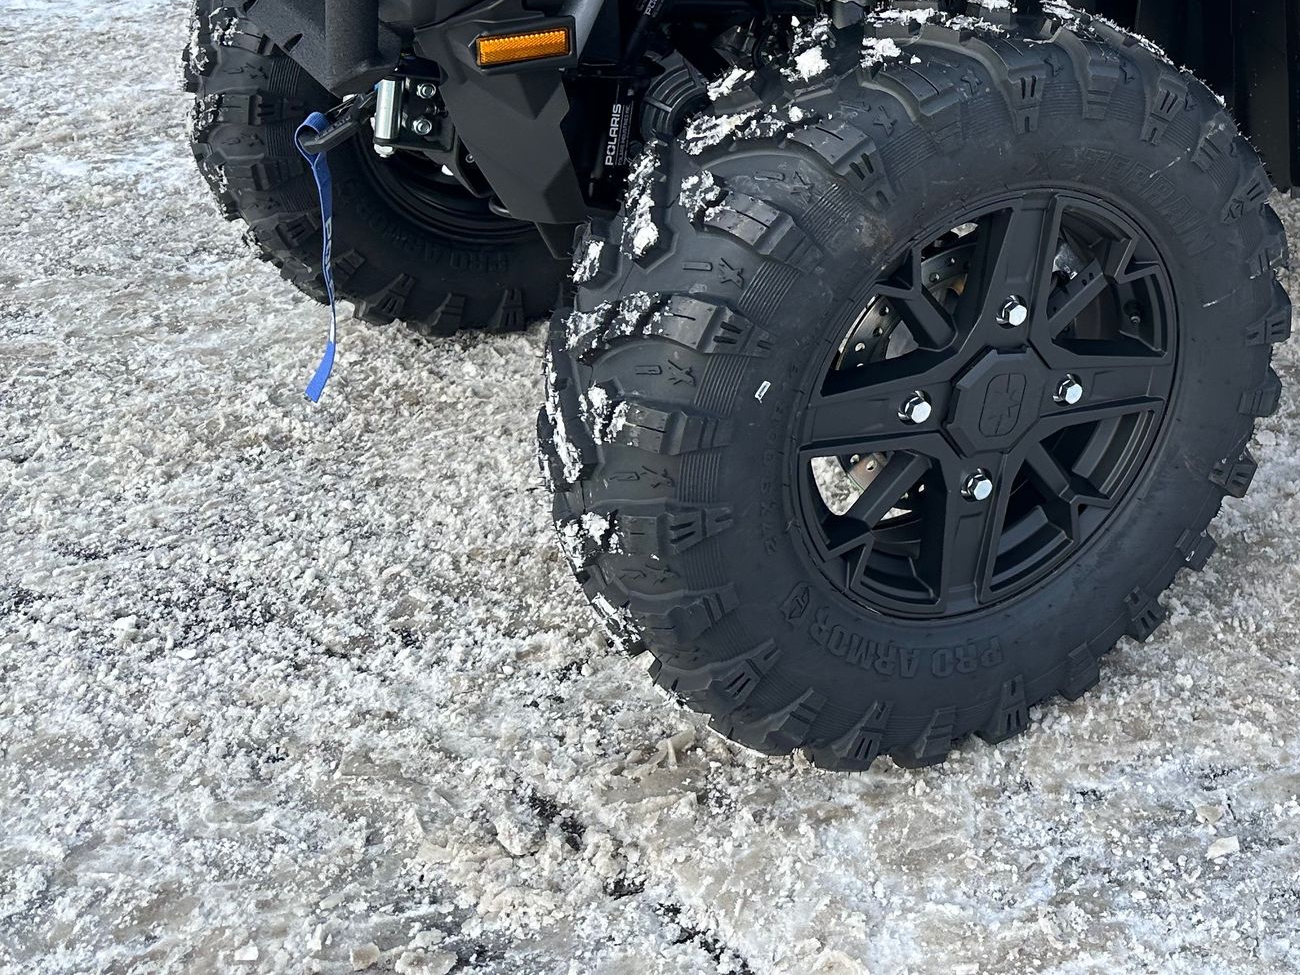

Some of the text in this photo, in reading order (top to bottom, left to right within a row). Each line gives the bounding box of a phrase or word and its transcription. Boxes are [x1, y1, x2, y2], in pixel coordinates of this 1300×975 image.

[605, 103, 622, 166] POLARIS
[807, 605, 1004, 679] PRO ARMOR
